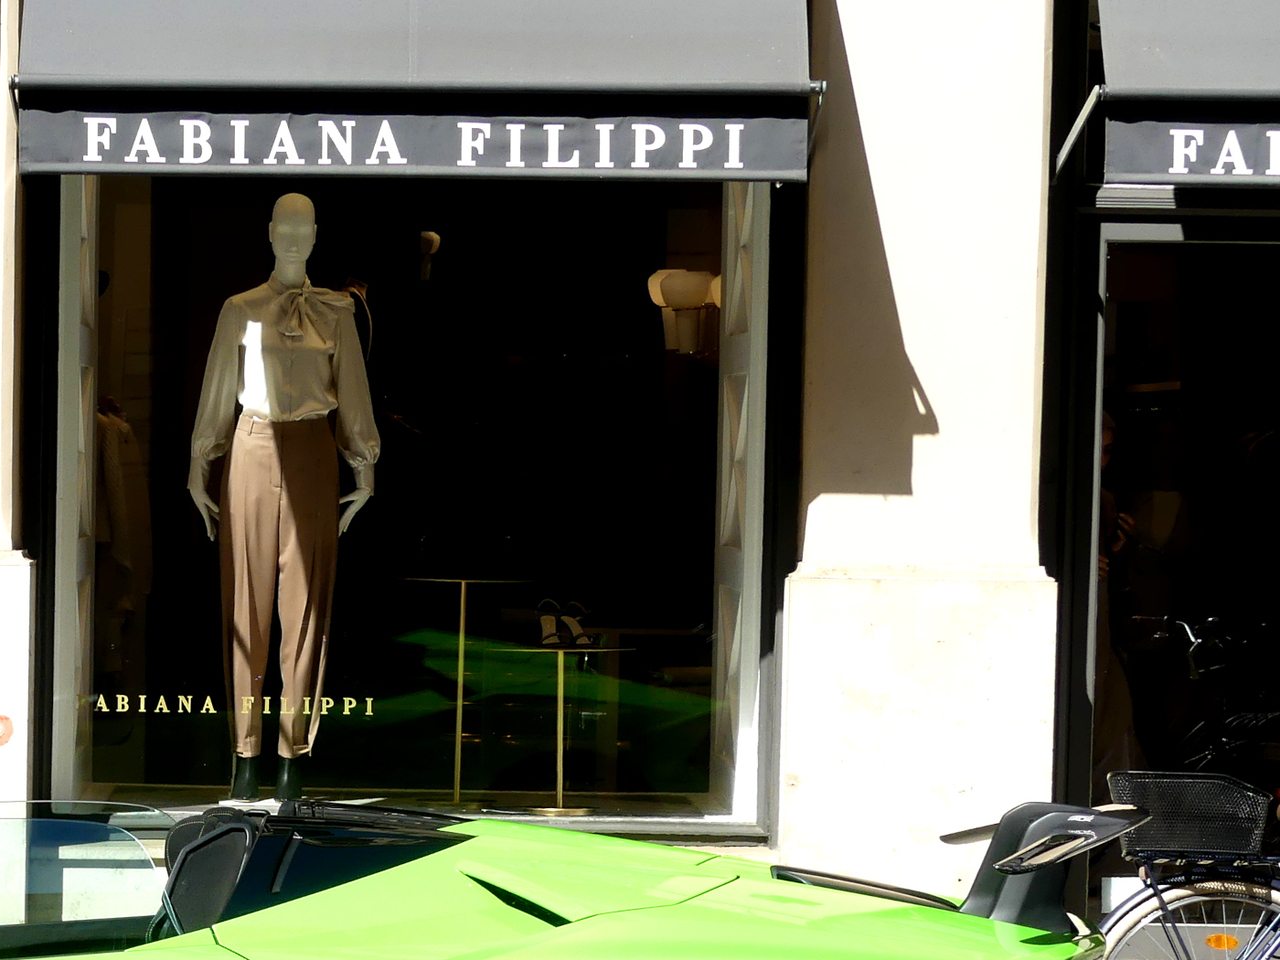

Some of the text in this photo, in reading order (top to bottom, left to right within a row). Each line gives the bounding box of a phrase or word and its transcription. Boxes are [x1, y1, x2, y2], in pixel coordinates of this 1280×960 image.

[82, 117, 745, 169] FABIANA FILIPPI
[241, 696, 374, 715] FILIPPI
